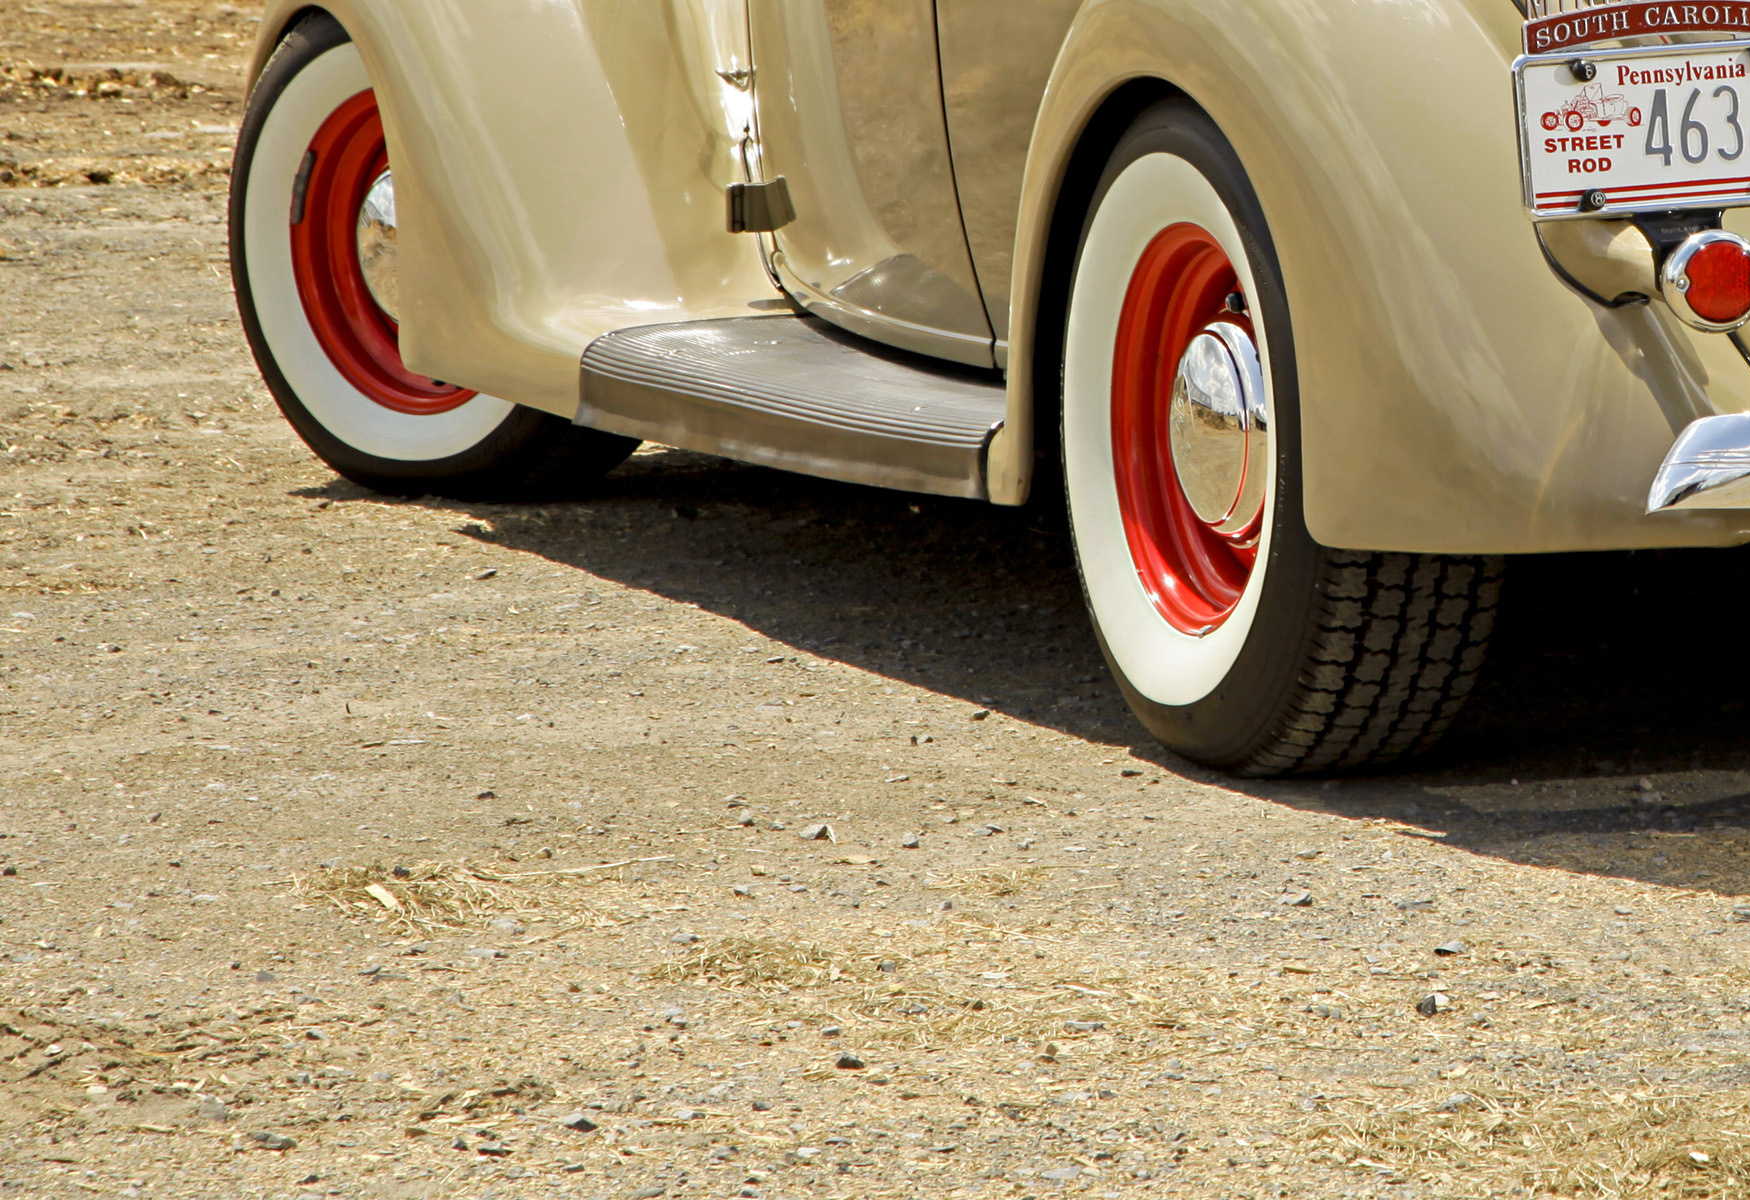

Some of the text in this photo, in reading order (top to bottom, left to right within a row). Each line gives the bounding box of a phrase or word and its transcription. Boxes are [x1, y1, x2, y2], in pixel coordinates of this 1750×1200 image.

[1535, 11, 1630, 49] SOUTH
[1617, 58, 1746, 86] Pennsylvania
[1544, 135, 1625, 153] STREET
[1568, 157, 1612, 173] ROD
